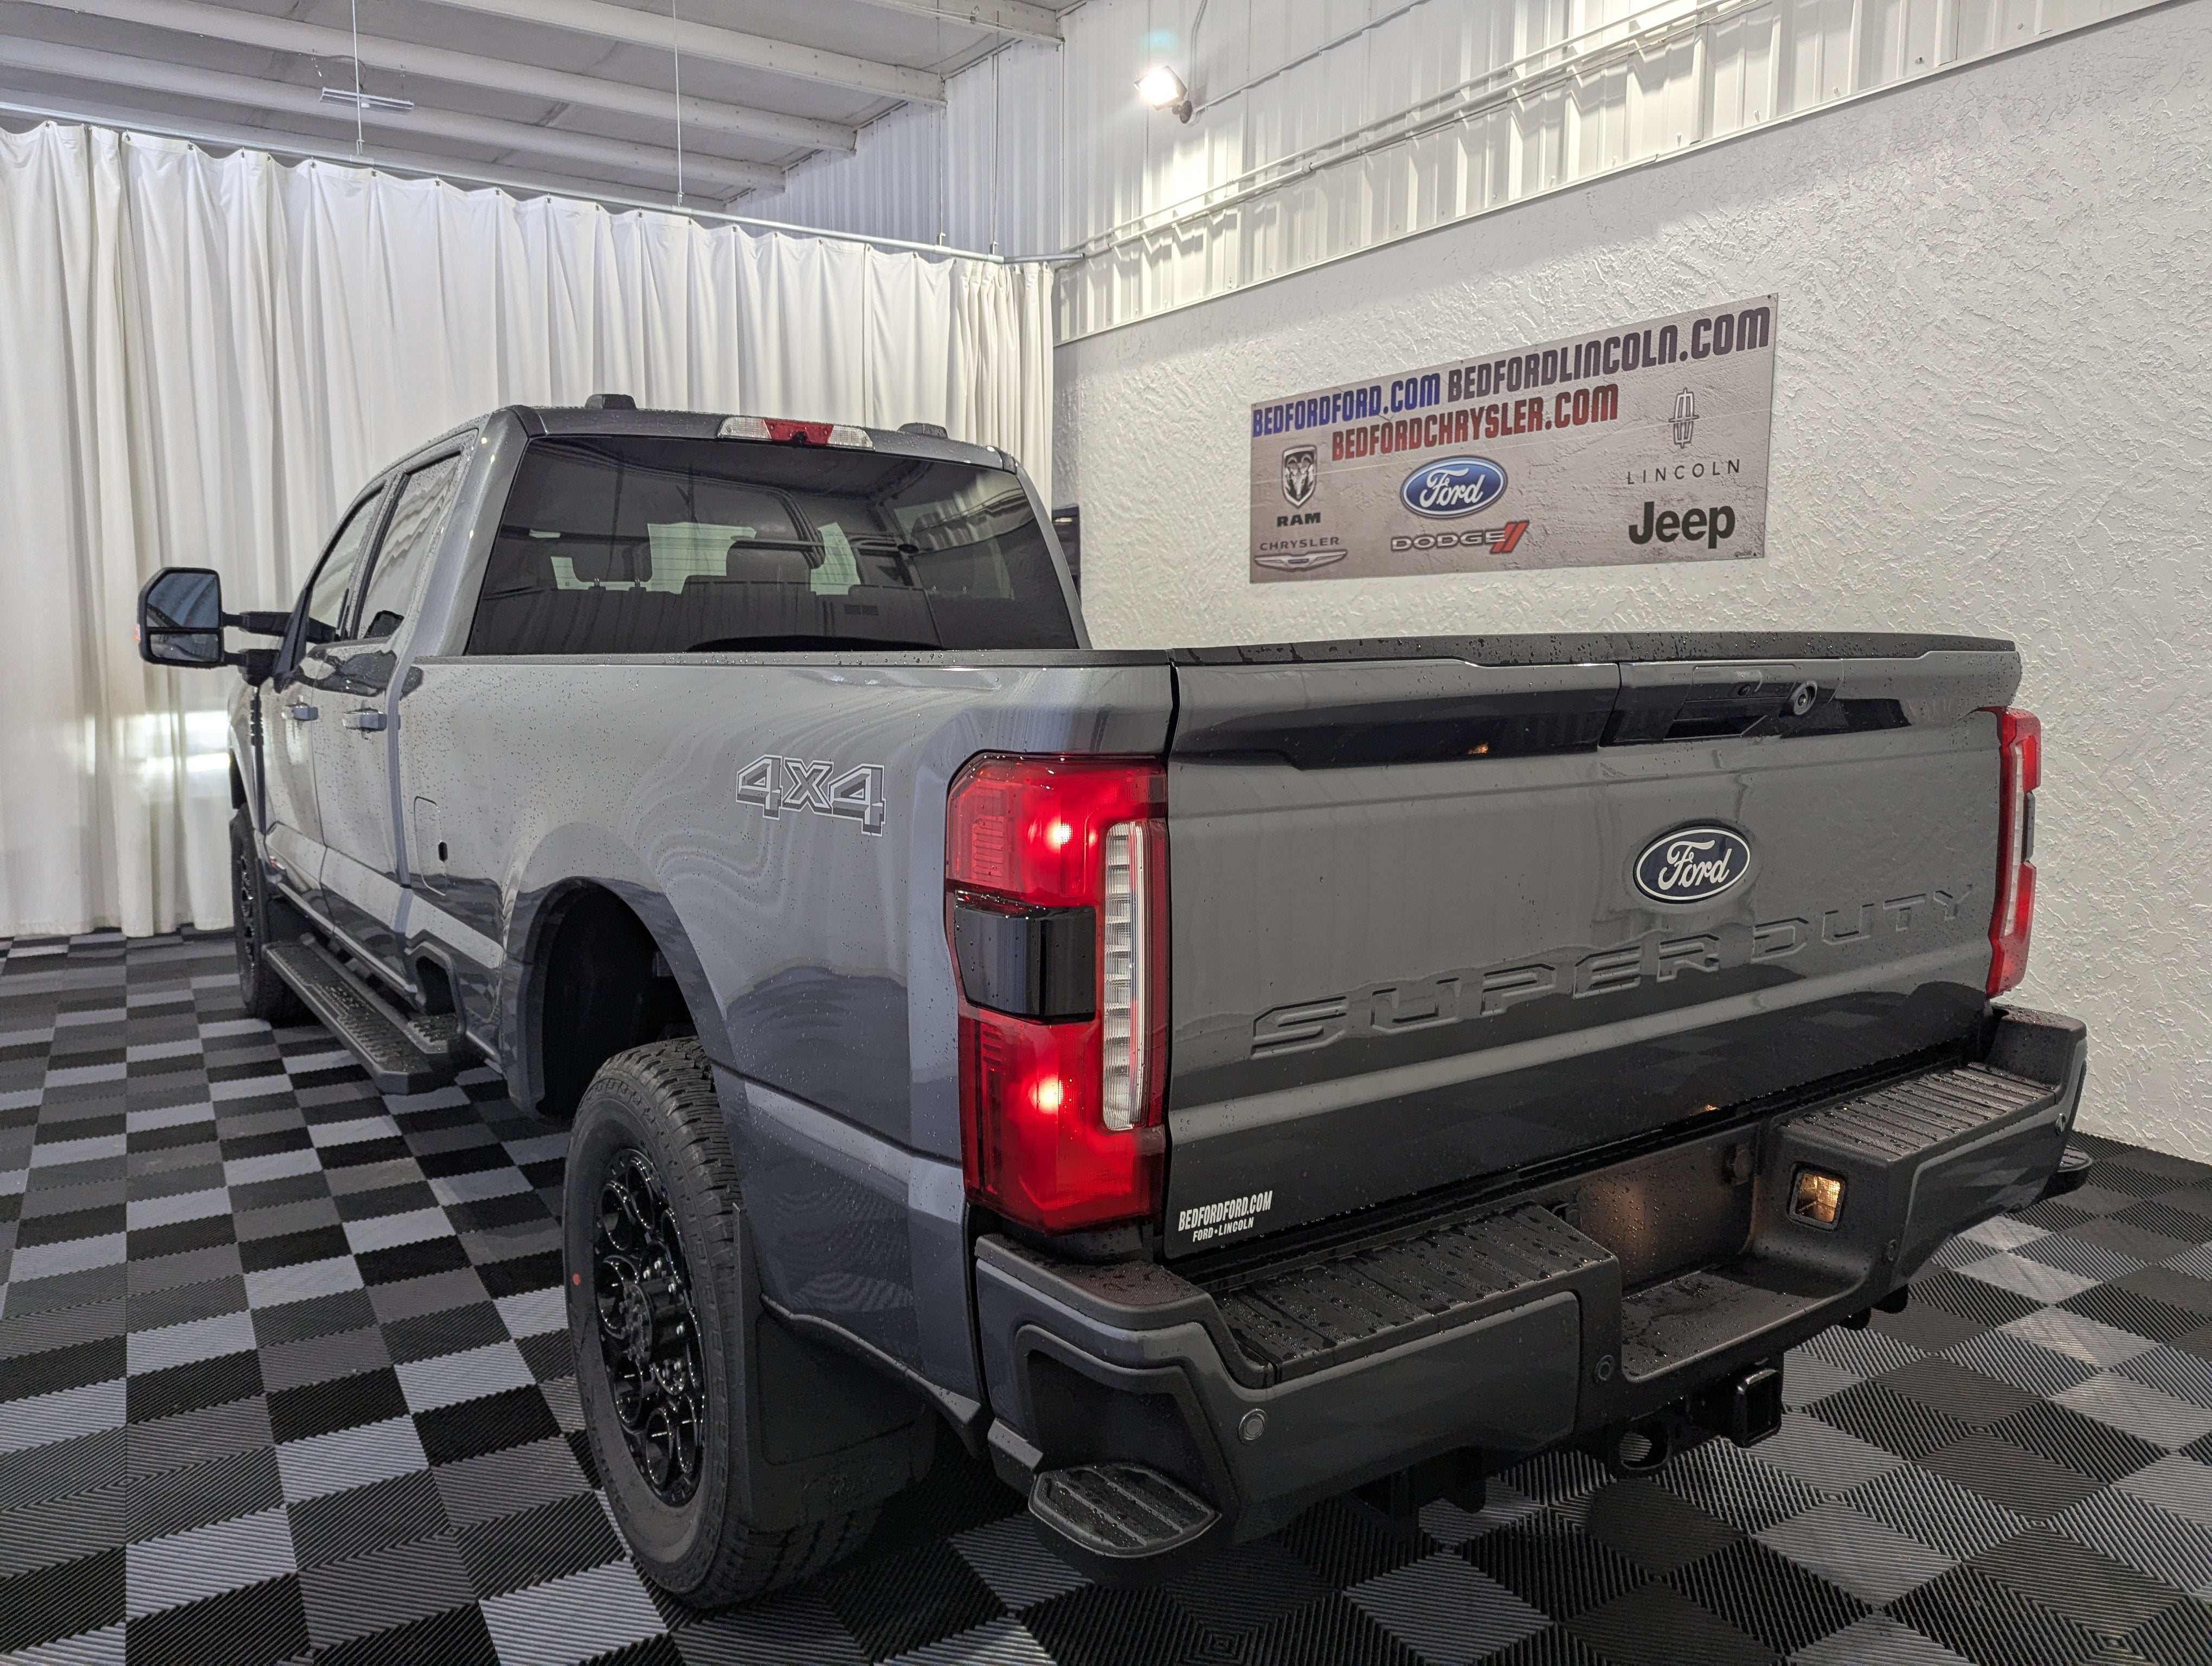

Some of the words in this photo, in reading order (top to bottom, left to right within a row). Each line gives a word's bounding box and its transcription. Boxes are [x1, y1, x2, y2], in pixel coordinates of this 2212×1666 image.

[1252, 373, 1441, 438] BEDFORDFORD.COM
[1448, 306, 1771, 403] BEDFORDLINCOLN.COM
[1332, 383, 1619, 462] BEDFORDCHRYSLER.COM
[1419, 467, 1486, 508] Ford
[1627, 459, 1740, 485] LINCOLN
[1276, 512, 1321, 528] RAM
[1391, 529, 1507, 552] DODGE
[1628, 501, 1735, 549] Jeep
[1259, 536, 1340, 551] CHRYSLER
[1658, 840, 1732, 890] Ford
[1250, 933, 1720, 1060] SUPER
[1750, 885, 1973, 964] DUTY
[1178, 1190, 1273, 1232] BEDFORDFORD.COM
